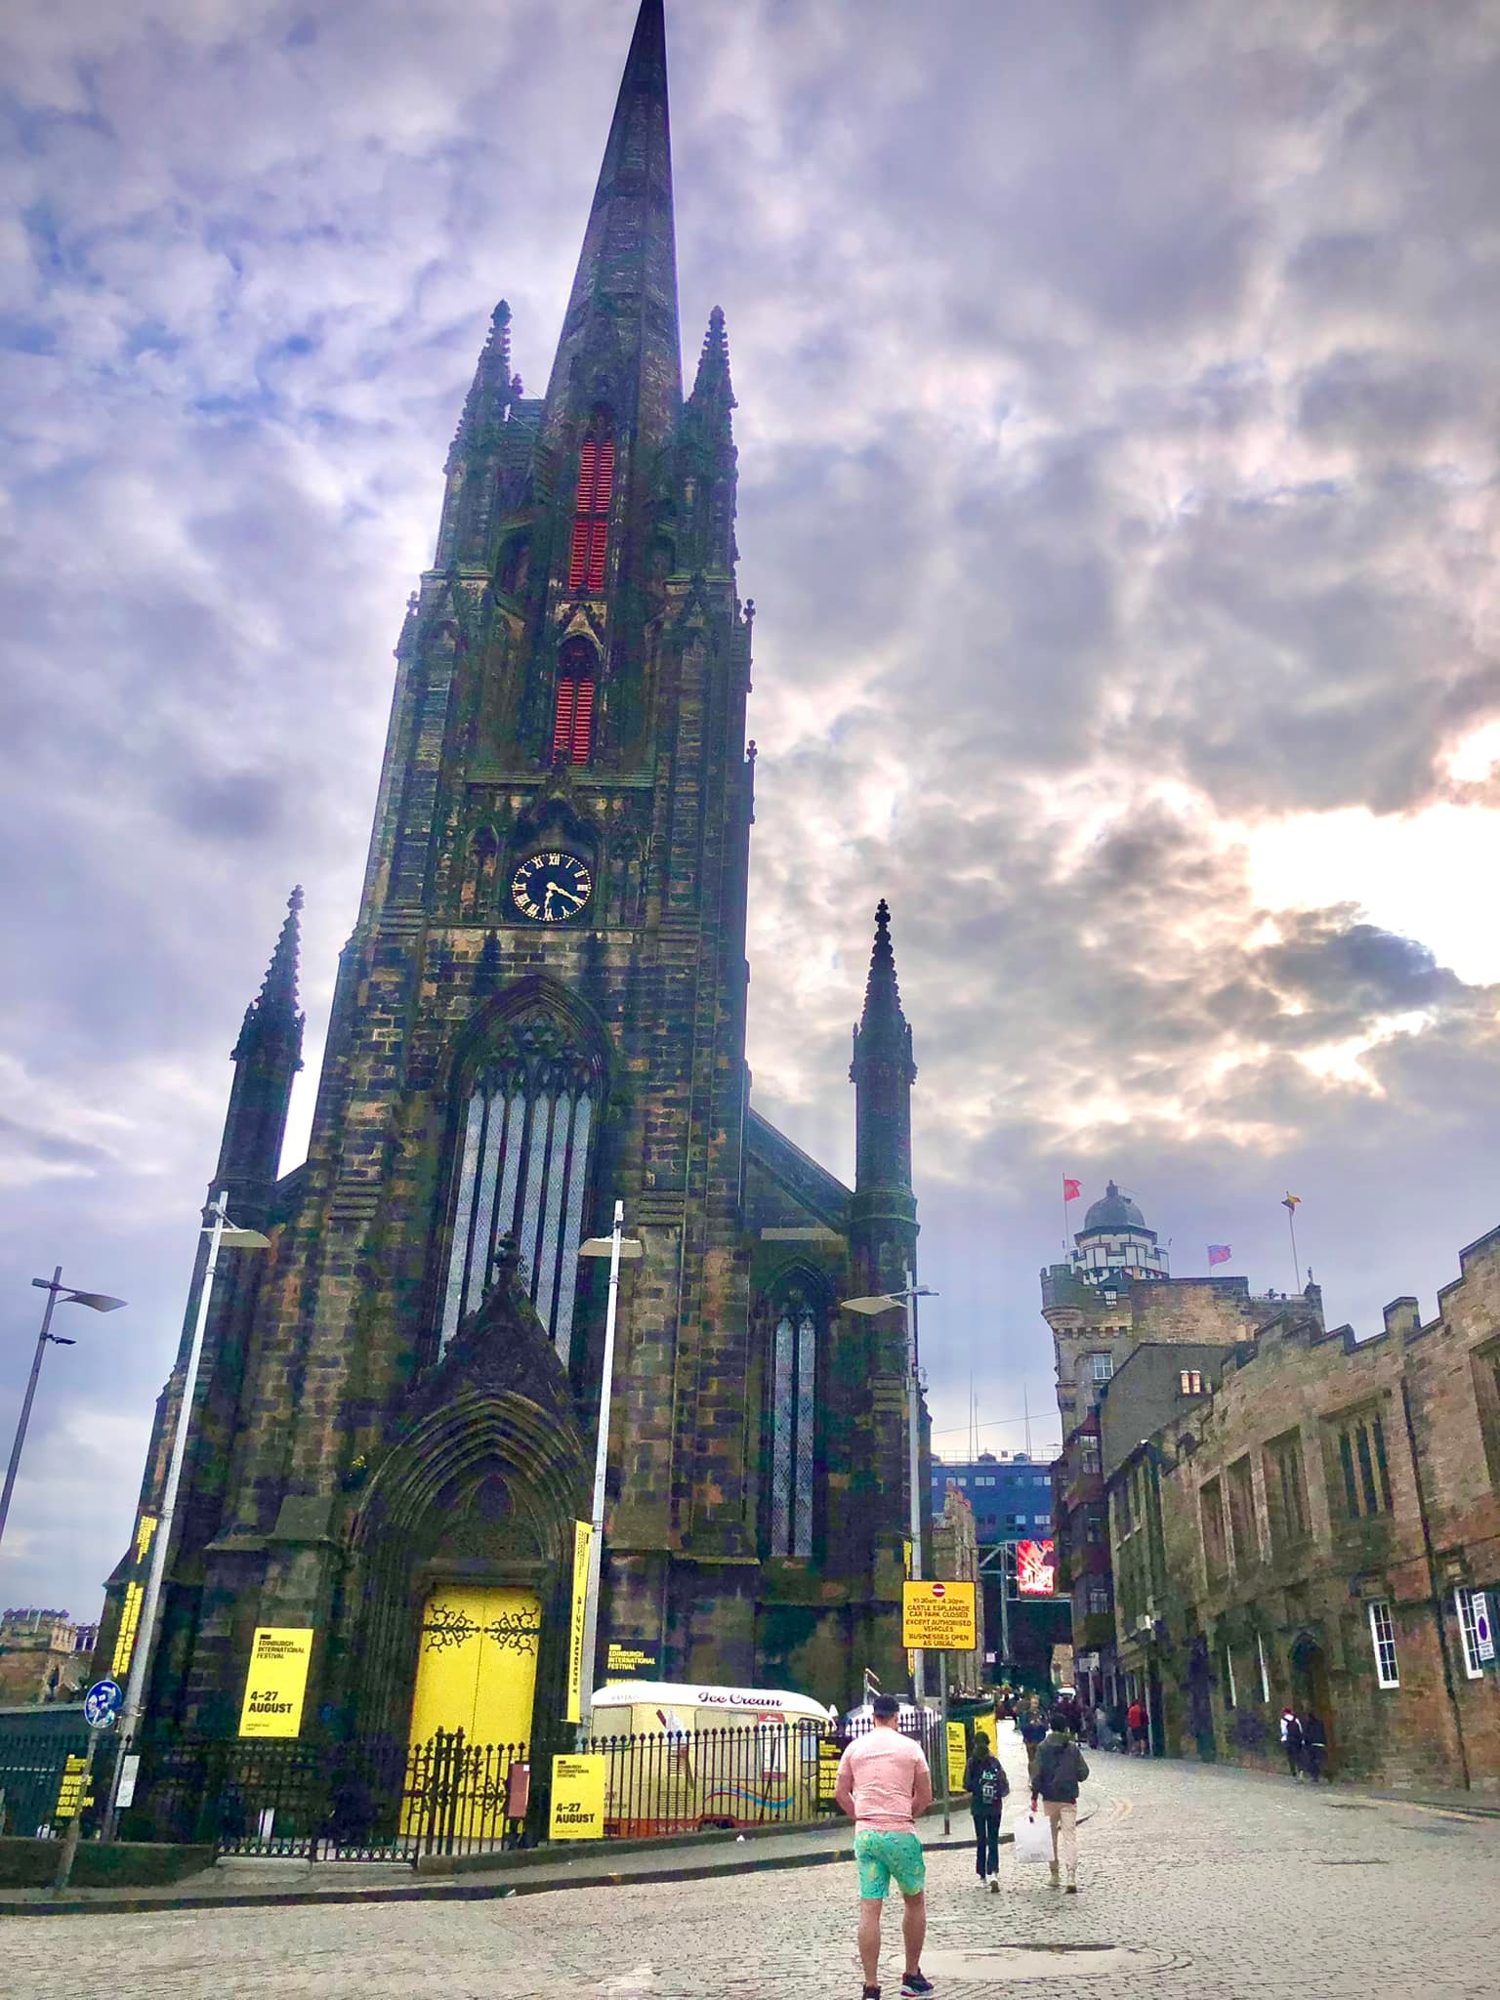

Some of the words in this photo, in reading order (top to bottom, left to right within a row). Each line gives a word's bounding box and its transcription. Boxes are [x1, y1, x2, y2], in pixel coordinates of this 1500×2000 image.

[572, 1635, 581, 1695] AUGUST
[698, 1692, 727, 1704] Ice
[729, 1693, 783, 1707] Cream
[248, 1702, 293, 1713] AUGUST
[555, 1813, 595, 1823] AUGUST
